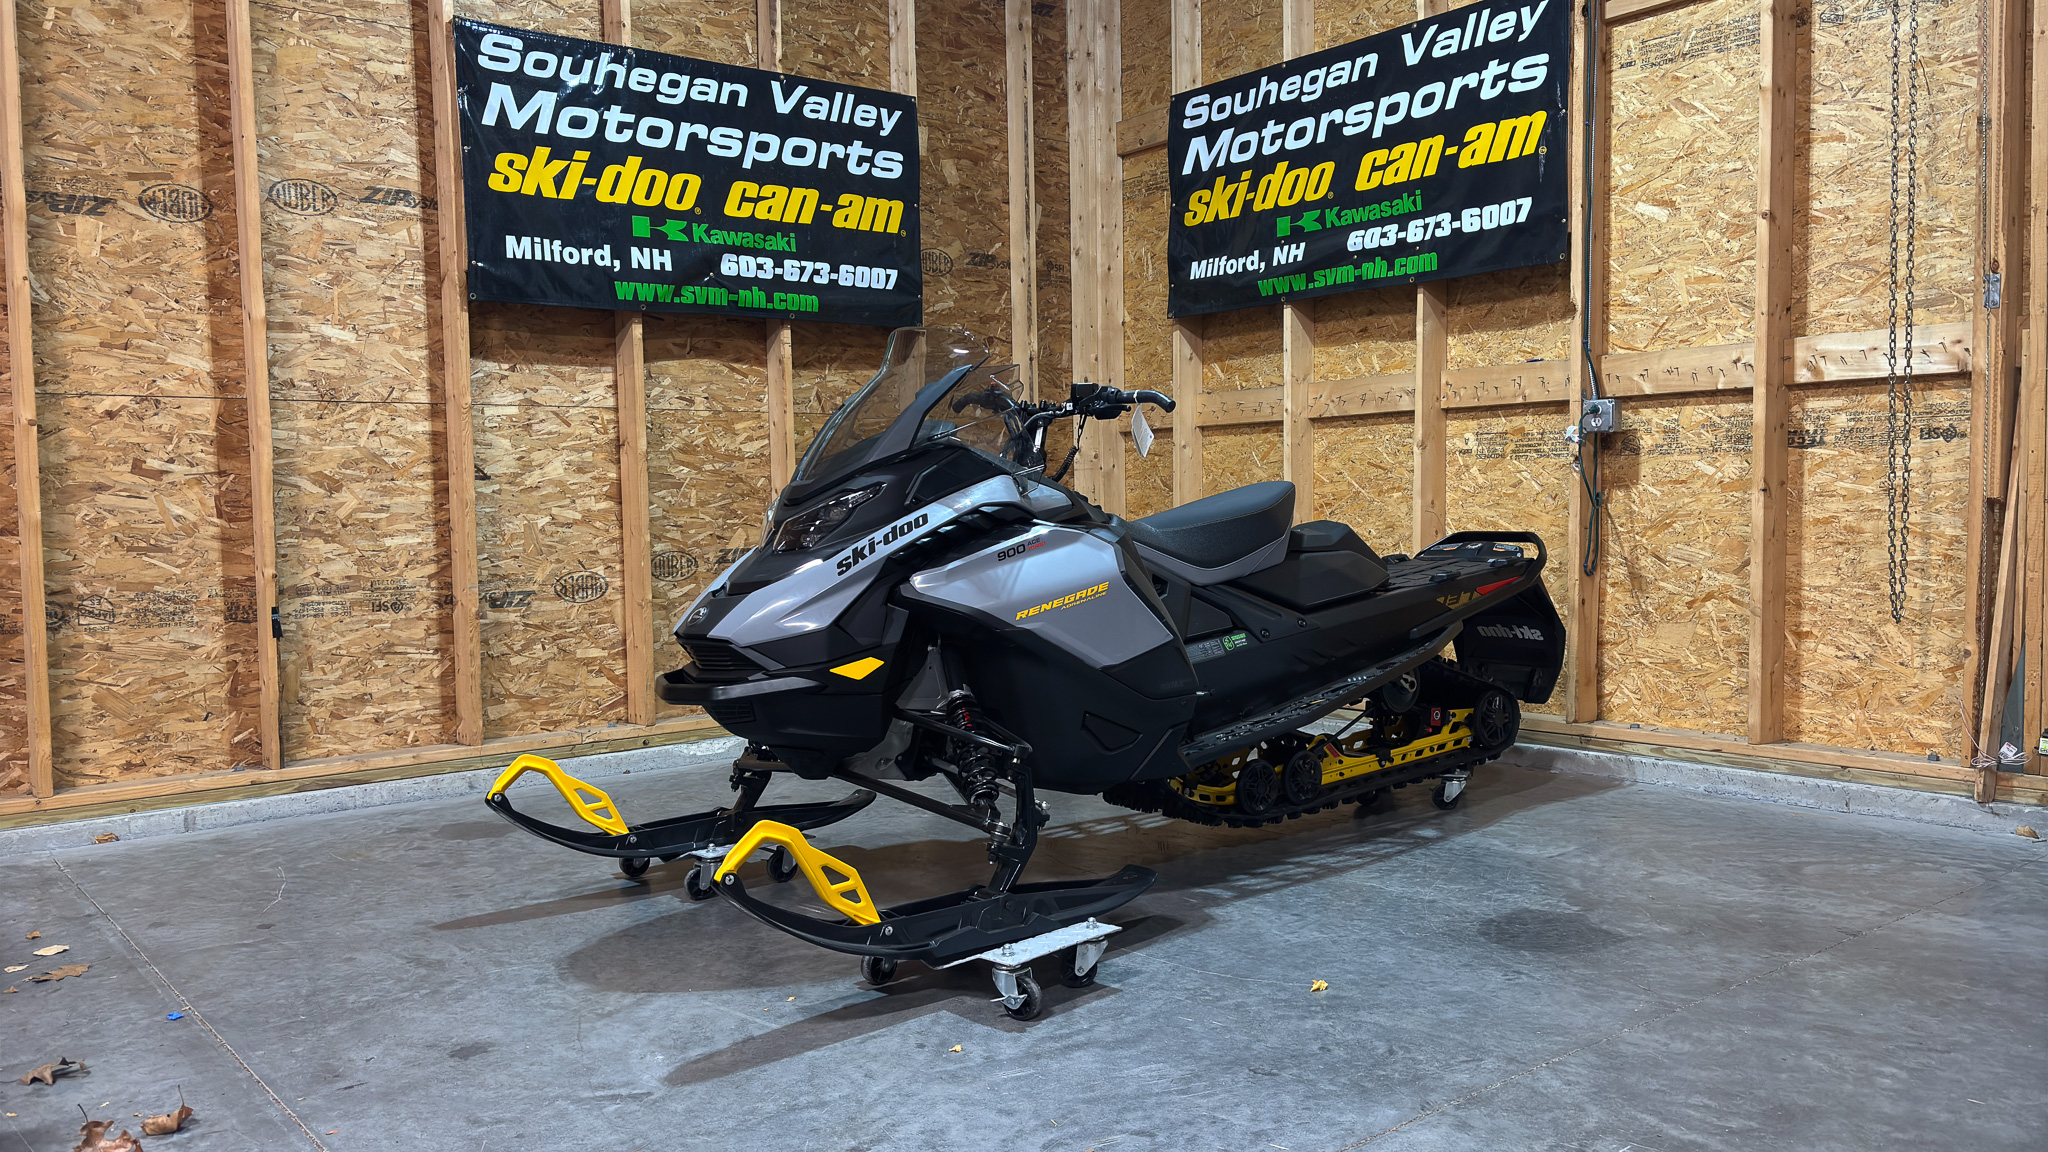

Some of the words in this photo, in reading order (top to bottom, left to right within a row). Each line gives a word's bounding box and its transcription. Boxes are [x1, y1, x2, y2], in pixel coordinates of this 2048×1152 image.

[478, 33, 748, 108] Souhegan
[771, 80, 902, 137] Valley
[1183, 52, 1379, 129] Souhegan
[1401, 0, 1550, 67] Valley
[481, 82, 904, 180] Motorsports
[1182, 53, 1550, 176] Motorsports
[488, 146, 702, 211] ski-doo
[724, 180, 904, 235] can-am
[1184, 160, 1336, 227] ski-doo
[1354, 110, 1548, 192] can-am
[1325, 190, 1422, 229] Kawasaki
[1347, 197, 1532, 252] 603-673-6007
[505, 234, 621, 273] Milford,
[631, 246, 673, 271] NH
[693, 222, 797, 252] Kawasaki
[720, 253, 898, 290] 603-673-6007
[1189, 249, 1266, 281] Milford,
[1273, 242, 1305, 265] NH
[1258, 250, 1438, 297] www.svm-nh.com
[615, 280, 819, 312] www.svm-nh.com
[837, 513, 928, 576] ski-doo
[998, 544, 1026, 561] 900
[1016, 582, 1109, 620] RENEGADE
